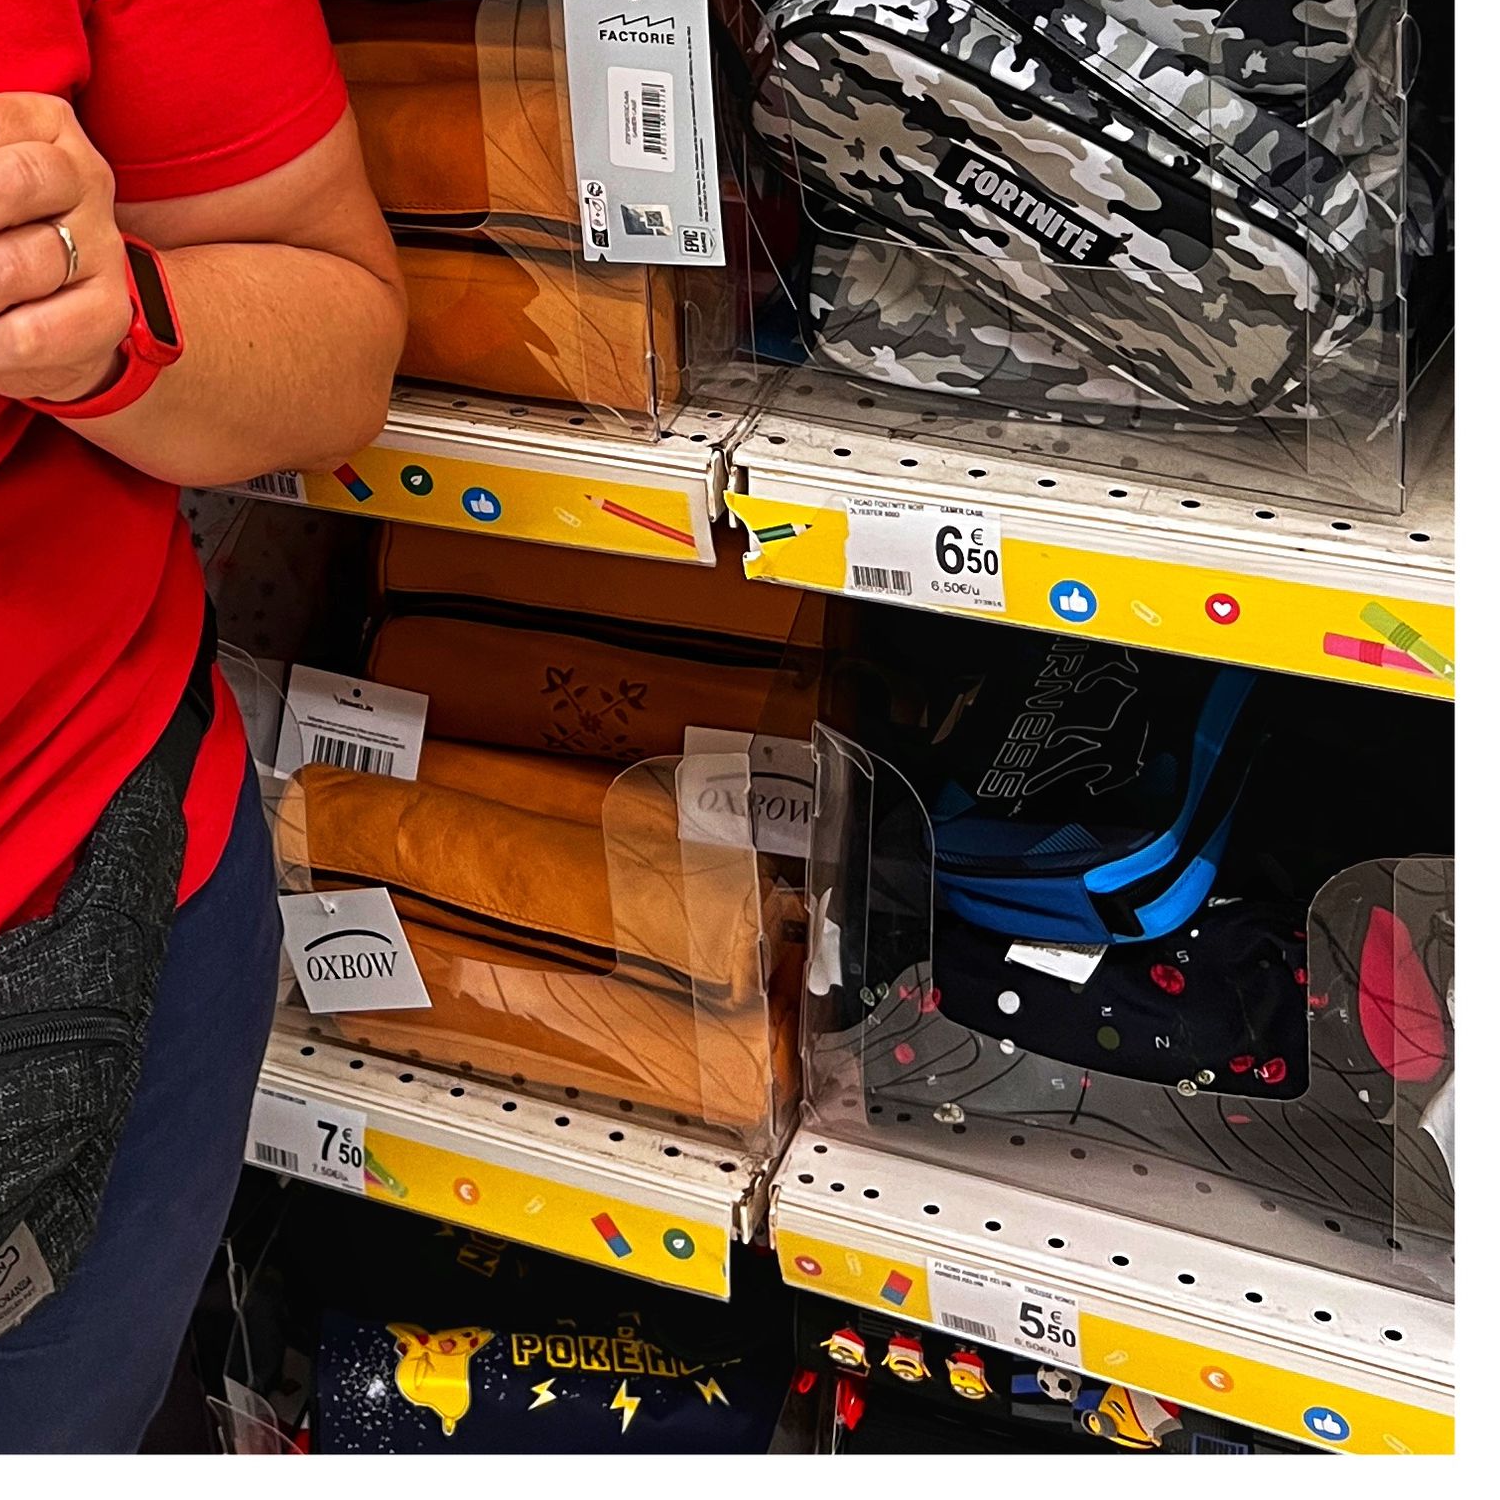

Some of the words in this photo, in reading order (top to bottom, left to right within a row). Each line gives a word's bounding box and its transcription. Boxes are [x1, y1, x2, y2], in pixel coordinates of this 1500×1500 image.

[600, 29, 676, 46] FACTORIE
[955, 157, 1098, 262] FORTNITE
[935, 525, 965, 575] 6
[971, 528, 984, 546] €
[967, 548, 999, 576] 50
[931, 581, 980, 596] 6,50€/u
[306, 950, 399, 984] OXBOW
[317, 1120, 338, 1161] 7
[339, 1143, 362, 1168] 50
[1019, 1301, 1046, 1339] 5
[1047, 1324, 1077, 1348] 50
